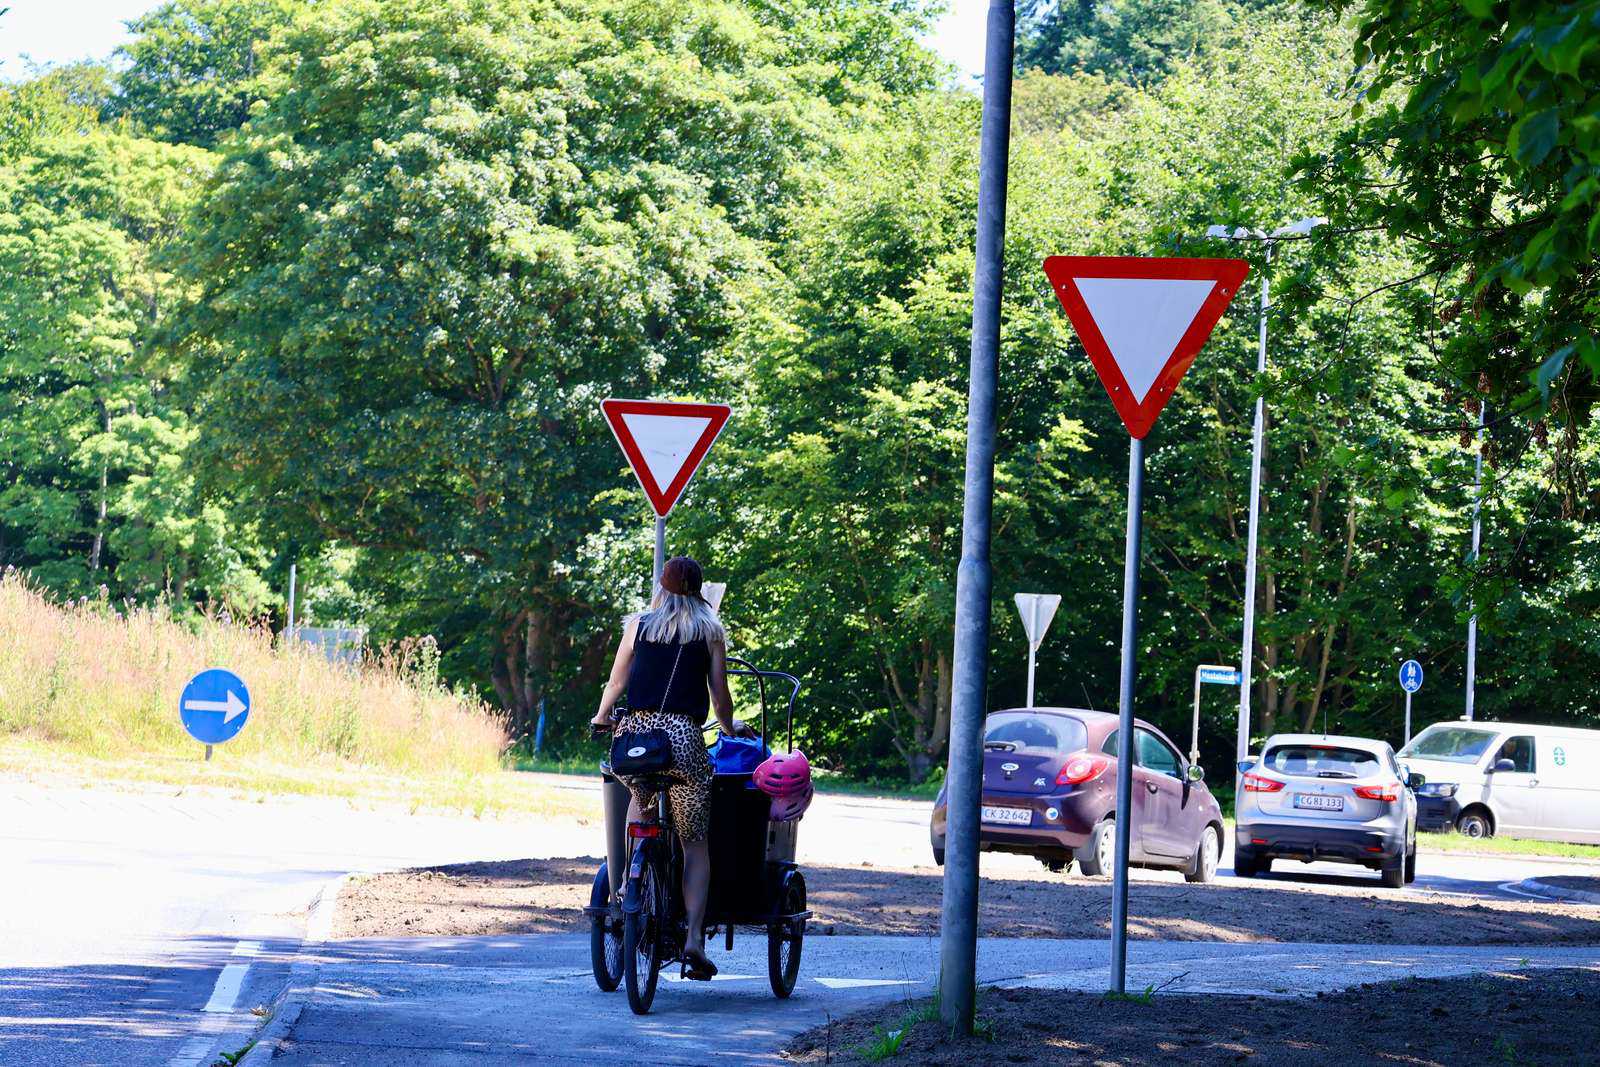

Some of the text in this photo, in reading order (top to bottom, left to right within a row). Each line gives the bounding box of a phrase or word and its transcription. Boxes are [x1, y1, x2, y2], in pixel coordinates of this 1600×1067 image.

[1327, 798, 1341, 807] 133
[984, 808, 996, 818] CK
[1012, 810, 1029, 820] 642
